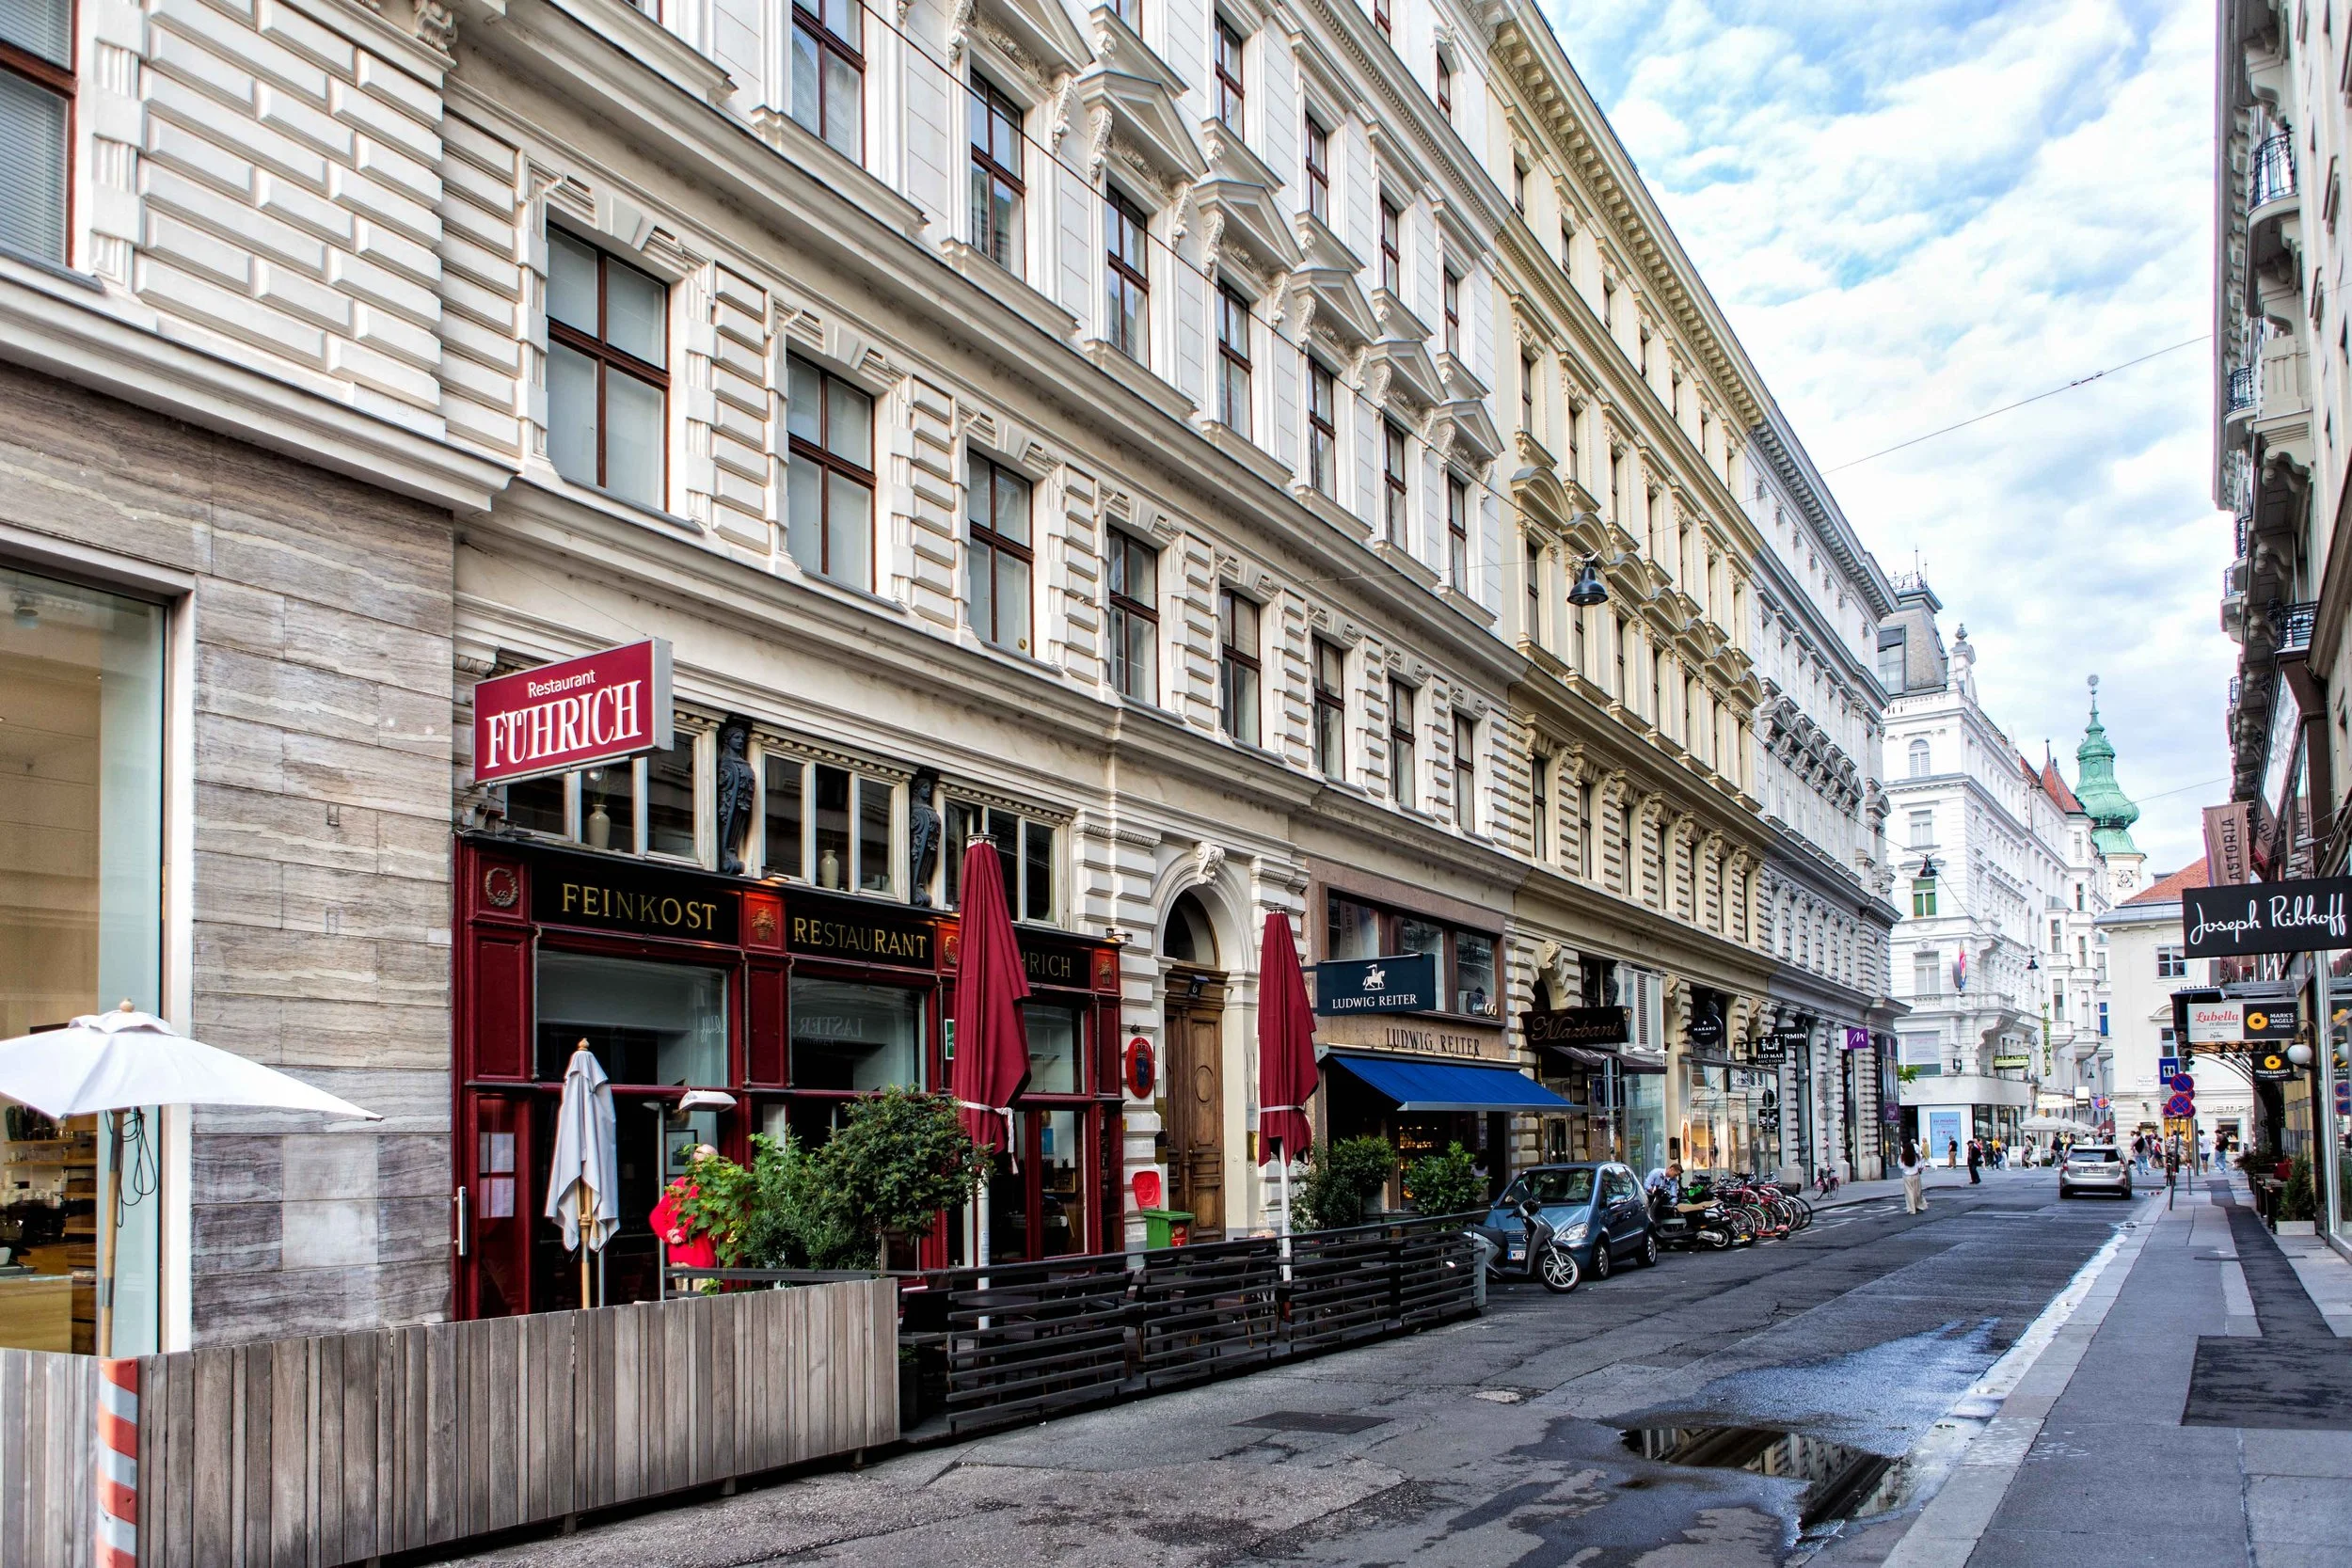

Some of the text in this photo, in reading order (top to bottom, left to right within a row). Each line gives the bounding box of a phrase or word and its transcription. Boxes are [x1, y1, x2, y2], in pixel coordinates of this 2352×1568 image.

[528, 669, 596, 698] Restaurant
[2221, 816, 2242, 880] ASTORIA
[562, 882, 1071, 978] FEINKOST RESTAURANT RICH
[2190, 894, 2346, 945] Joseph Ribkoff
[1192, 983, 1200, 994] 6
[1332, 993, 1418, 1009] LUDWIG REITER
[1532, 1016, 1621, 1041] Mazbani
[2196, 1010, 2239, 1023] Lubella
[1386, 1027, 1480, 1056] LUDWIG REITER
